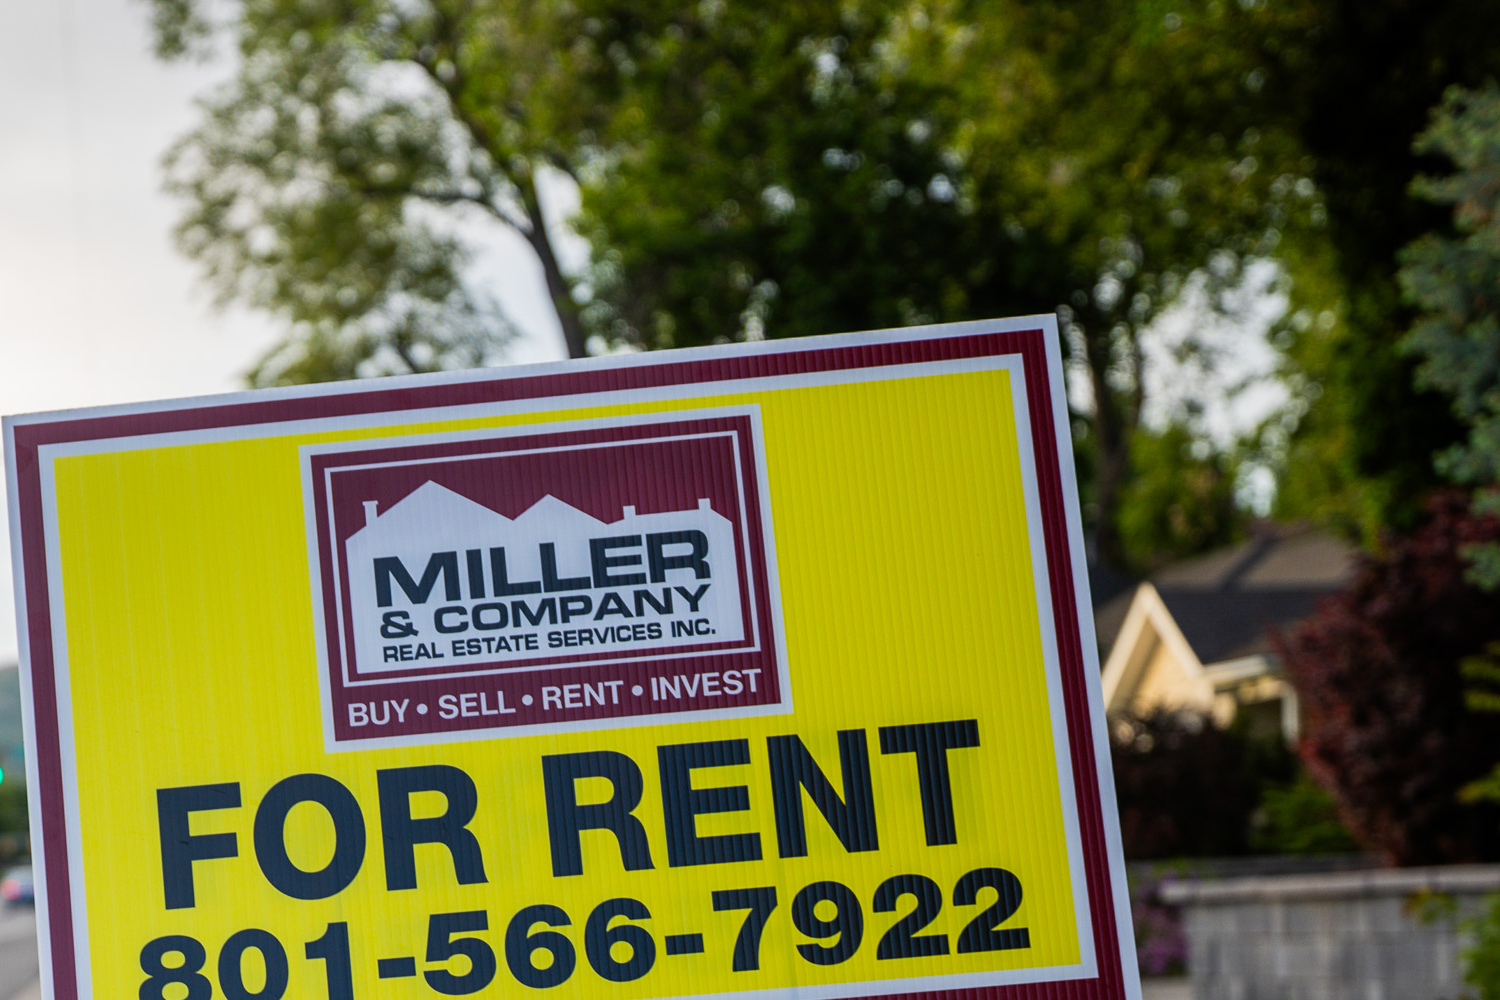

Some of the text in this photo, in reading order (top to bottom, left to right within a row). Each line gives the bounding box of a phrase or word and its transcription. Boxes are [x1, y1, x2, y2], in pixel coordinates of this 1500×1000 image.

[373, 528, 712, 607] MILLER
[380, 584, 711, 638] & COMPANY
[383, 618, 716, 663] REAL ESTATE SERVICES INC.
[347, 668, 762, 727] BUY SELL RENT INVEST
[155, 718, 980, 910] FOR RENT
